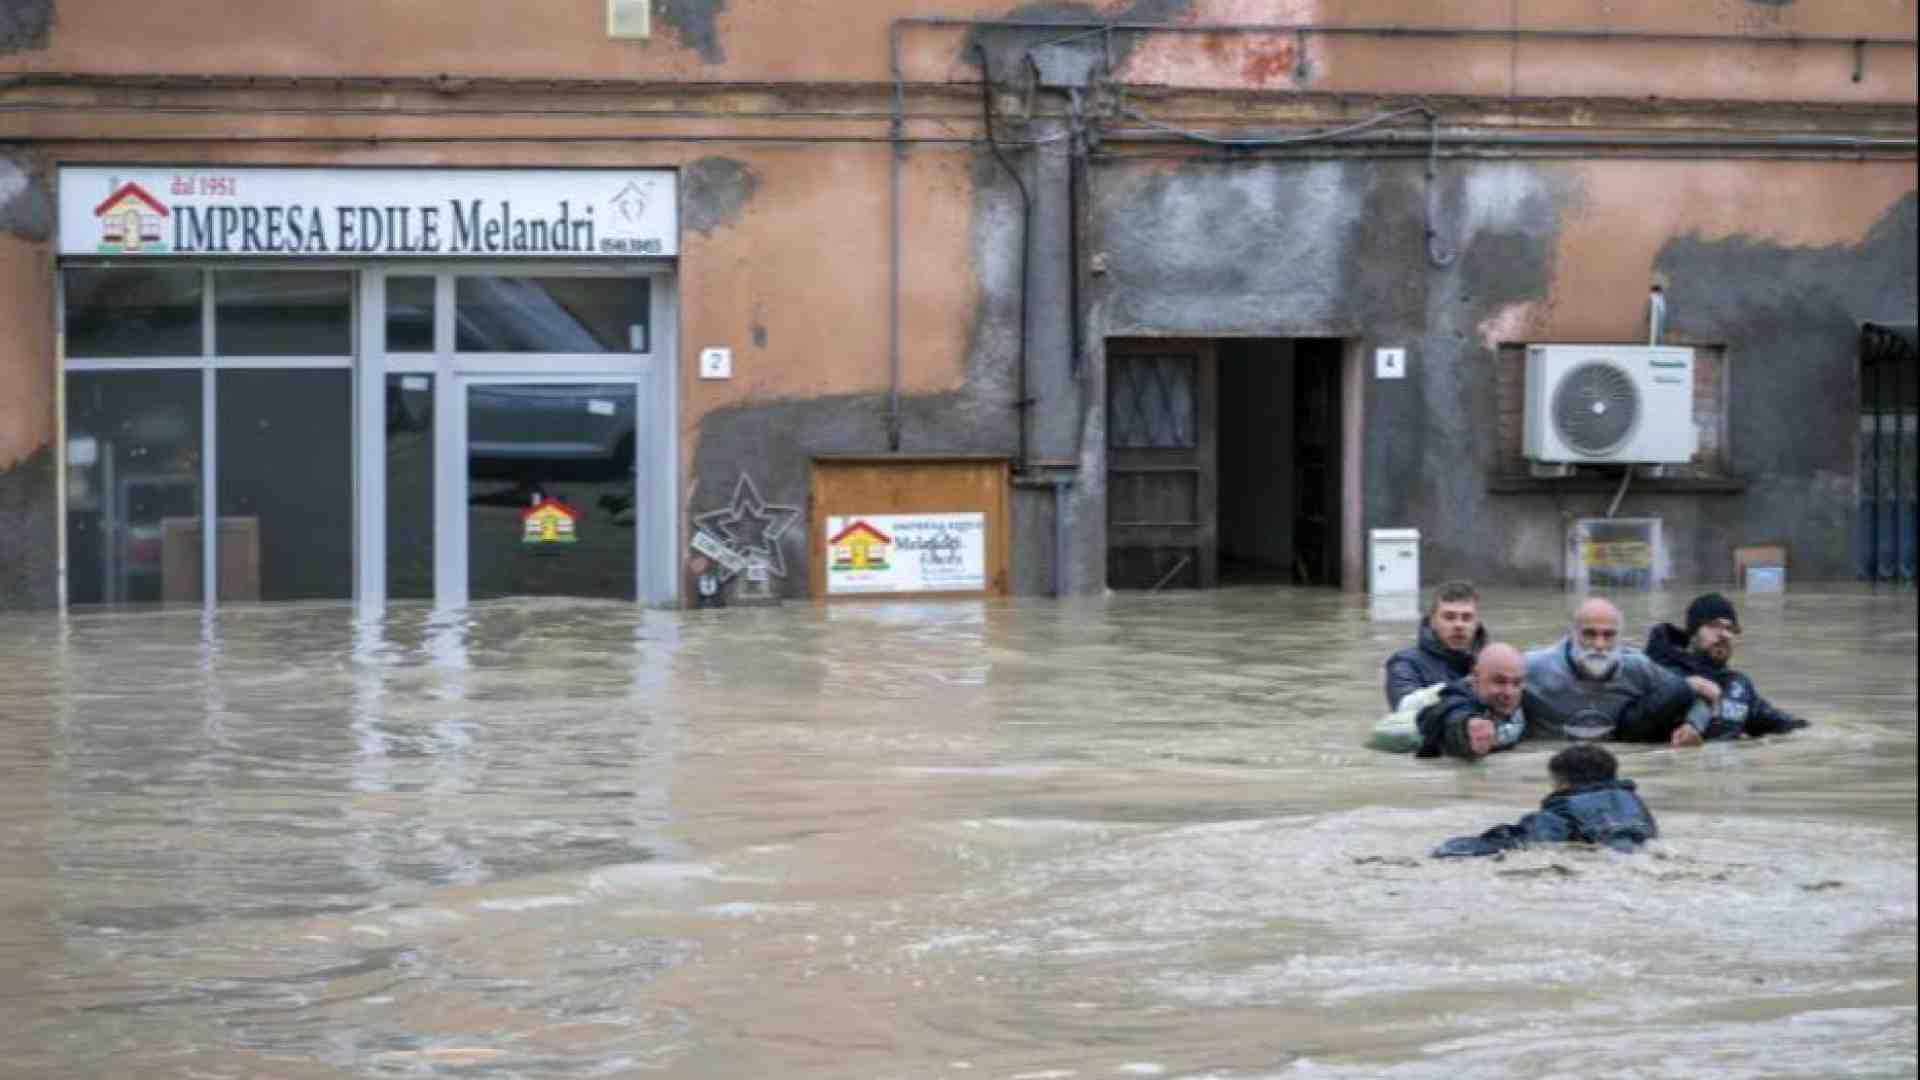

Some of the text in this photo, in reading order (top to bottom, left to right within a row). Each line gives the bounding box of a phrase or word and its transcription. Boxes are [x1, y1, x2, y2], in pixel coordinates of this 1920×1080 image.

[171, 175, 236, 196] dal 1951
[172, 198, 596, 251] IMPRESA EDILE Melandri
